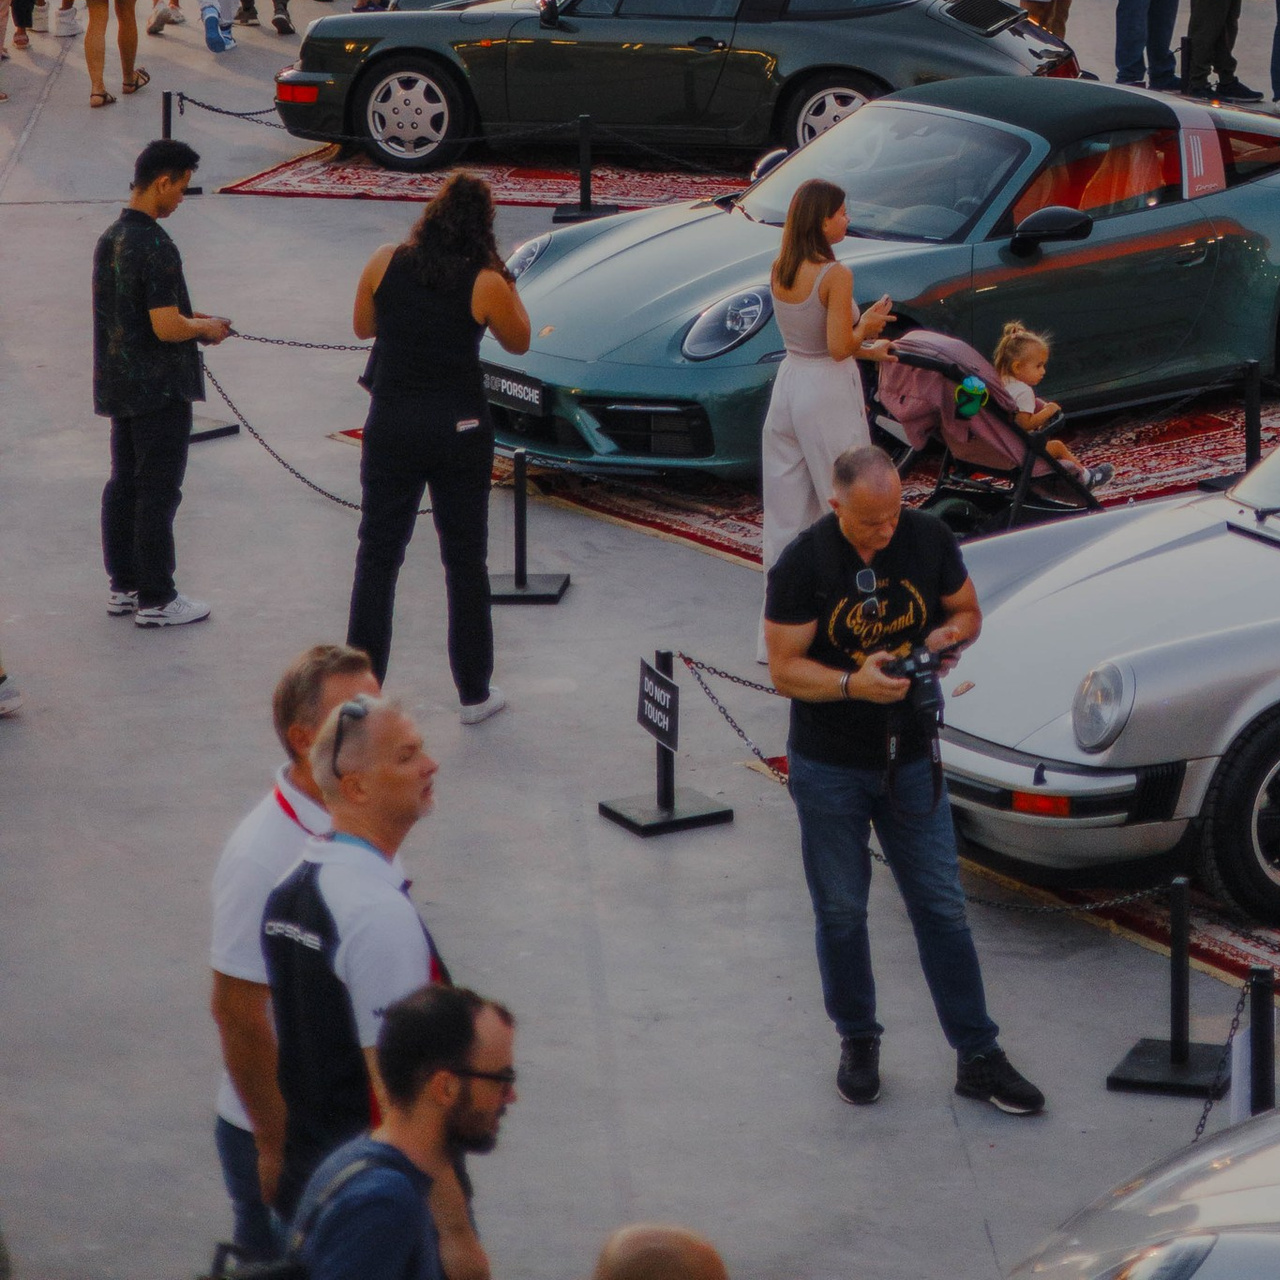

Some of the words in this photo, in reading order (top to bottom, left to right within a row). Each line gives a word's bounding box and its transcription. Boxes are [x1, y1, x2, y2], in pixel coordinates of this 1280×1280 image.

[501, 379, 540, 404] PORSCHE
[644, 676, 654, 697] DO
[654, 686, 671, 708] NOT
[644, 699, 669, 732] TOUCH
[264, 919, 322, 952] ORSCHE
